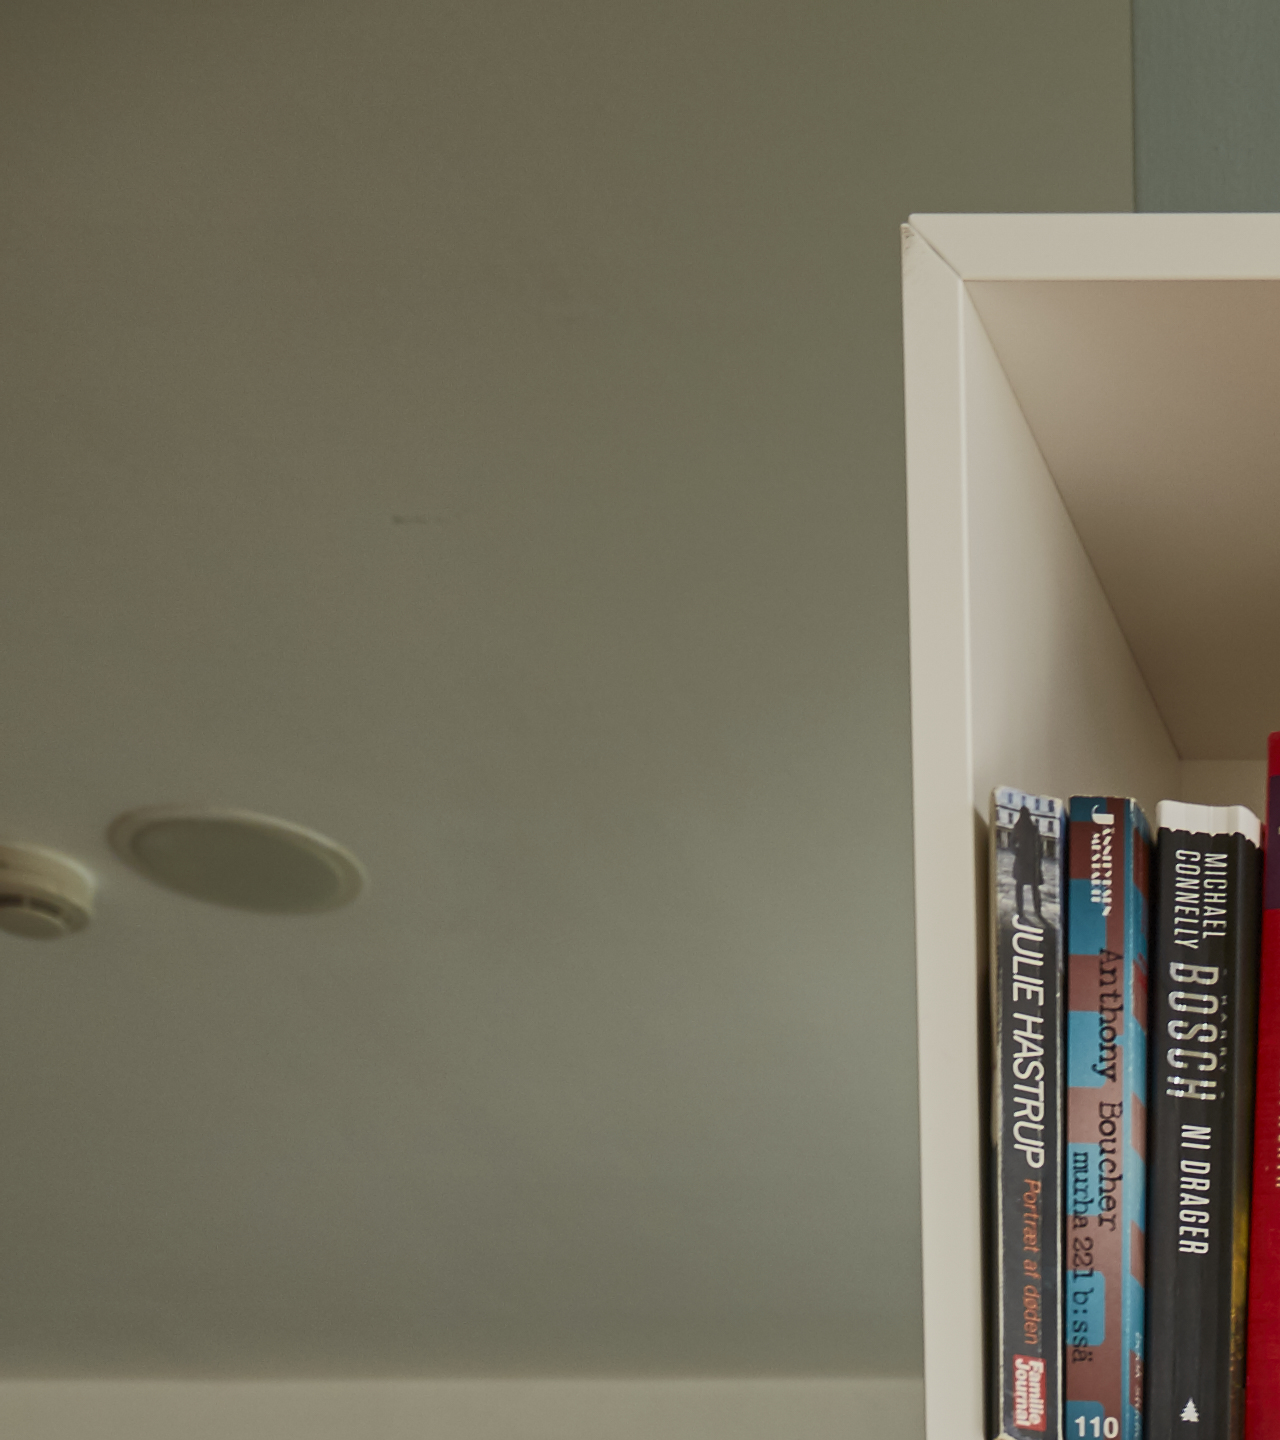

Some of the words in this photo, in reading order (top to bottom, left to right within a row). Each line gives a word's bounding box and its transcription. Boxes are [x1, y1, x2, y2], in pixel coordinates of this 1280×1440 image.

[1175, 849, 1197, 947] CONNELLY
[1204, 852, 1226, 939] MICHAEL
[1010, 913, 1044, 1006] JULIE
[1092, 947, 1122, 1085] Anthony
[1167, 962, 1217, 1099] BOSCH
[1011, 1011, 1045, 1169] HASTRUP
[1097, 1101, 1122, 1231] Boucher
[1014, 1357, 1031, 1427] Journal
[1028, 1361, 1045, 1426] Familie
[1074, 1417, 1119, 1440] 110
